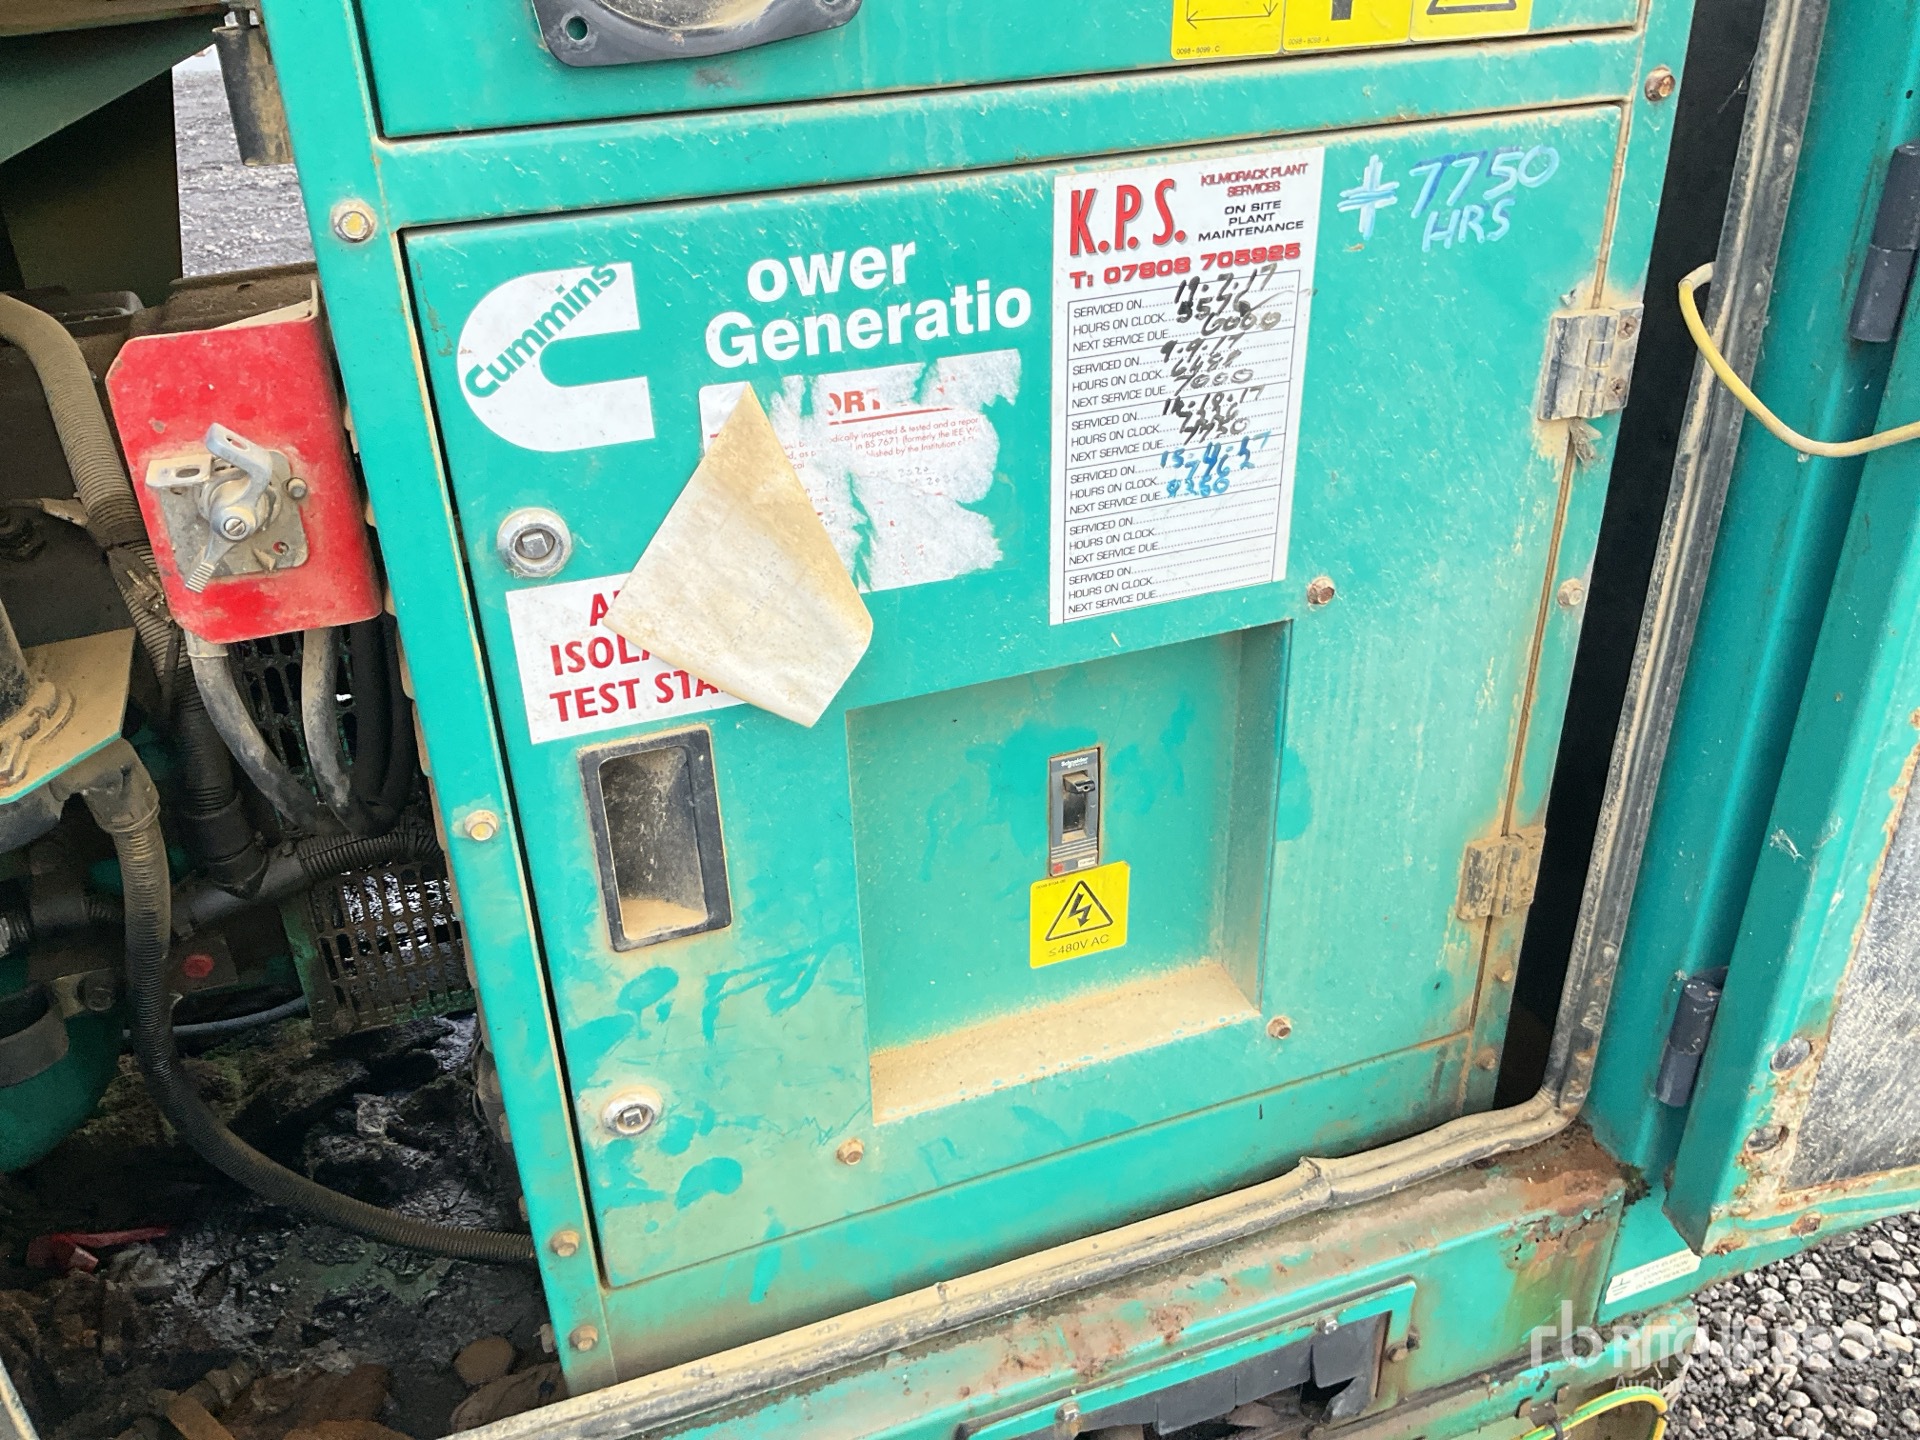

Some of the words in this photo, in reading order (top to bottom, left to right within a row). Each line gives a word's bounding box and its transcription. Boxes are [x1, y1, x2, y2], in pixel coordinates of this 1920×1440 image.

[1200, 168, 1269, 187] KILMORACK
[1270, 163, 1309, 179] PLANT
[1408, 144, 1560, 219] 7750
[1227, 180, 1281, 198] SERVICES
[1224, 204, 1246, 215] ON
[1250, 200, 1282, 212] SITE
[1069, 178, 1187, 257] K.P.S.
[1228, 212, 1276, 226] PLANT
[1422, 196, 1516, 252] HRS
[1198, 220, 1304, 242] MAINTENANCE
[1069, 271, 1094, 289] T:
[1103, 257, 1191, 285] 07808
[1073, 302, 1123, 318] SERVICED
[463, 263, 620, 399] Cummins
[1073, 321, 1110, 336] HOURS
[1113, 318, 1128, 330] ON
[1073, 339, 1101, 353] NEXT
[1103, 332, 1145, 348] SERVICE
[1072, 359, 1121, 375] SERVICED
[1072, 378, 1108, 392] HOURS
[1111, 375, 1126, 386] ON
[1072, 395, 1099, 409] NEXT
[1101, 389, 1142, 404] SERVICE
[861, 427, 898, 440] inspected
[899, 425, 907, 433] &
[908, 423, 931, 433] tested
[933, 421, 949, 429] and
[1071, 414, 1119, 431] SERVICED
[865, 440, 875, 449] BS
[877, 437, 899, 447] 7671
[902, 434, 936, 445] (formerly
[938, 431, 950, 439] the
[951, 428, 964, 437] IEE
[1071, 433, 1107, 447] HOURS
[1109, 430, 1124, 441] ON
[896, 446, 906, 457] by
[908, 445, 919, 453] the
[921, 440, 956, 452] Institution
[1070, 450, 1097, 463] NEXT
[1099, 443, 1140, 458] SERVICE
[1070, 468, 1118, 484] SERVICED
[1070, 486, 1106, 500] HOURS
[1107, 483, 1122, 494] ON
[1070, 503, 1096, 515] NEXT
[1098, 496, 1138, 511] SERVICE
[1069, 520, 1116, 535] SERVICED
[1069, 537, 1103, 550] HOURS
[1105, 533, 1120, 544] ON
[1069, 553, 1094, 565] NEXT
[1096, 546, 1136, 561] SERVICE
[1069, 570, 1114, 585] SERVICED
[1068, 586, 1102, 599] HOURS
[1104, 583, 1119, 594] ON
[1068, 602, 1093, 615] NEXT
[1095, 595, 1134, 610] SERVICE
[550, 634, 652, 676] ISOL
[550, 677, 642, 722] TEST
[656, 669, 728, 704] STA
[1091, 933, 1110, 946] AC
